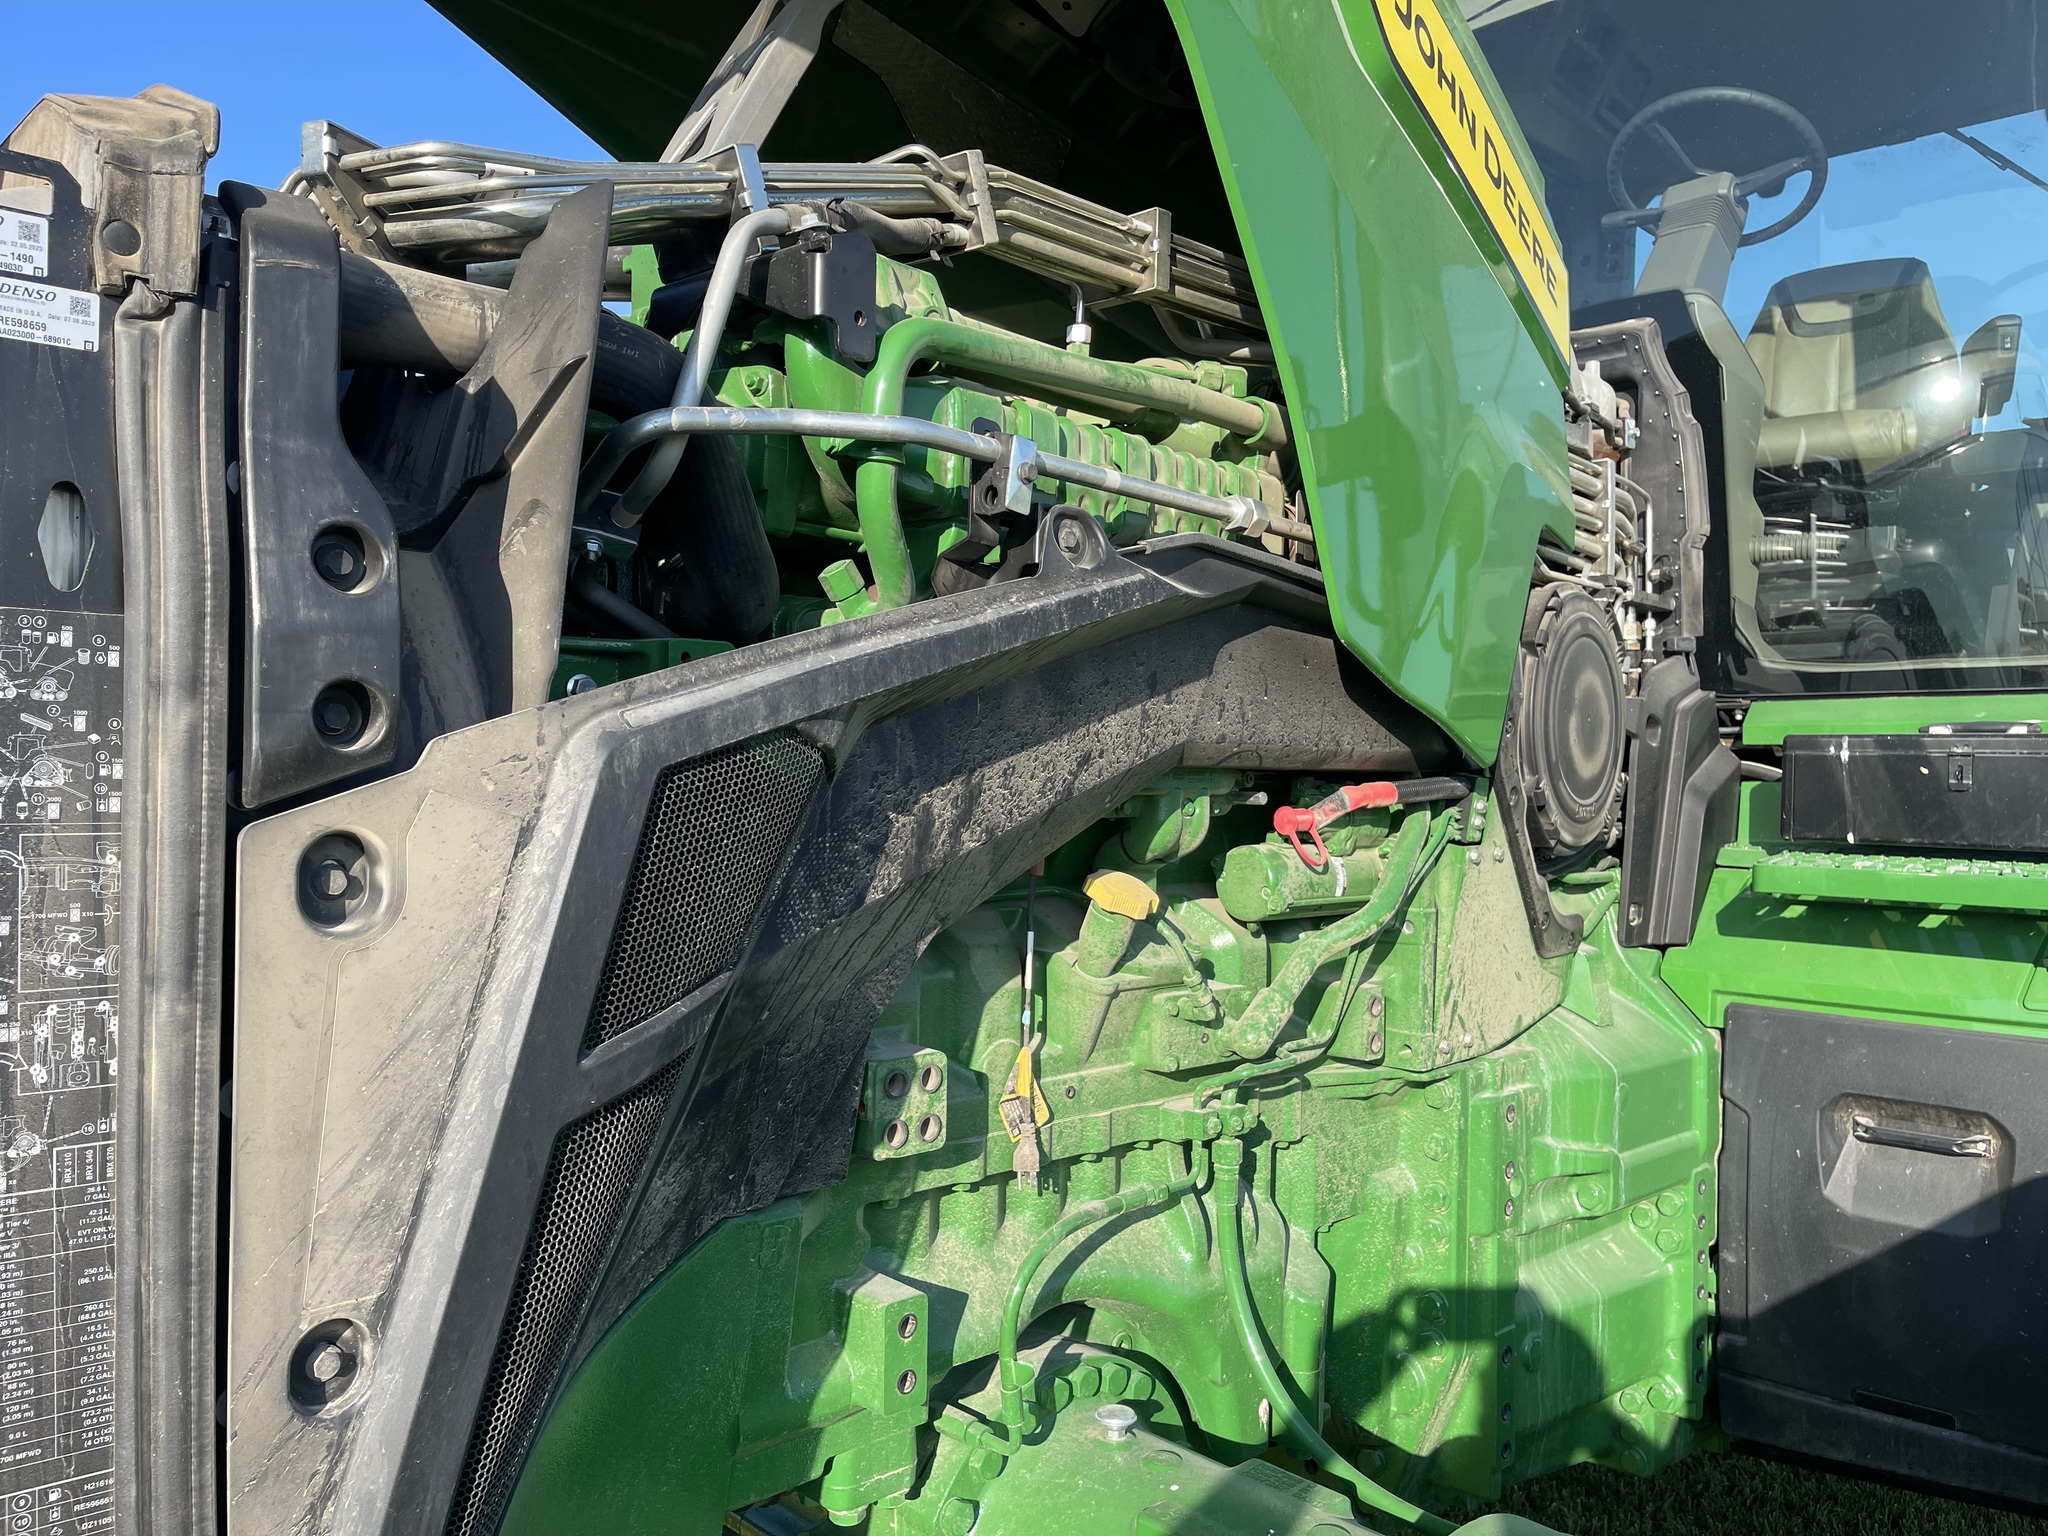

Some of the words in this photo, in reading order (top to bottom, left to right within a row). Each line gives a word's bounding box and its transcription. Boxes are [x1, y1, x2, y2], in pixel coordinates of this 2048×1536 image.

[1394, 0, 1476, 150] JOHN
[1484, 126, 1558, 308] DEERE
[0, 282, 56, 301] DENSO
[0, 315, 46, 332] RE598659
[78, 1277, 95, 1286] (66.1
[13, 1308, 24, 1316] m)
[78, 1313, 95, 1322] (68.8
[13, 1326, 24, 1334] m)
[80, 1334, 94, 1343] (4.4
[96, 1329, 115, 1339] GAL)
[2, 1347, 21, 1357] (1.93
[22, 1346, 33, 1354] m)
[80, 1354, 94, 1364] (5.3
[96, 1350, 115, 1360] GAL)
[22, 1368, 34, 1376] m)
[80, 1375, 94, 1384] (7.2
[96, 1370, 115, 1380] GAL)
[2, 1391, 21, 1400] (2.24
[22, 1388, 34, 1397] m)
[80, 1396, 94, 1406] (9.0
[96, 1392, 115, 1402] GAL)
[2, 1413, 21, 1423] (3.05
[22, 1410, 34, 1420] m)
[81, 1410, 101, 1418] 473.2
[83, 1417, 97, 1427] (0.5
[98, 1414, 112, 1423] QT)
[84, 1439, 92, 1448] (4
[93, 1435, 112, 1444] QTS)
[16, 1450, 41, 1460] MFWD
